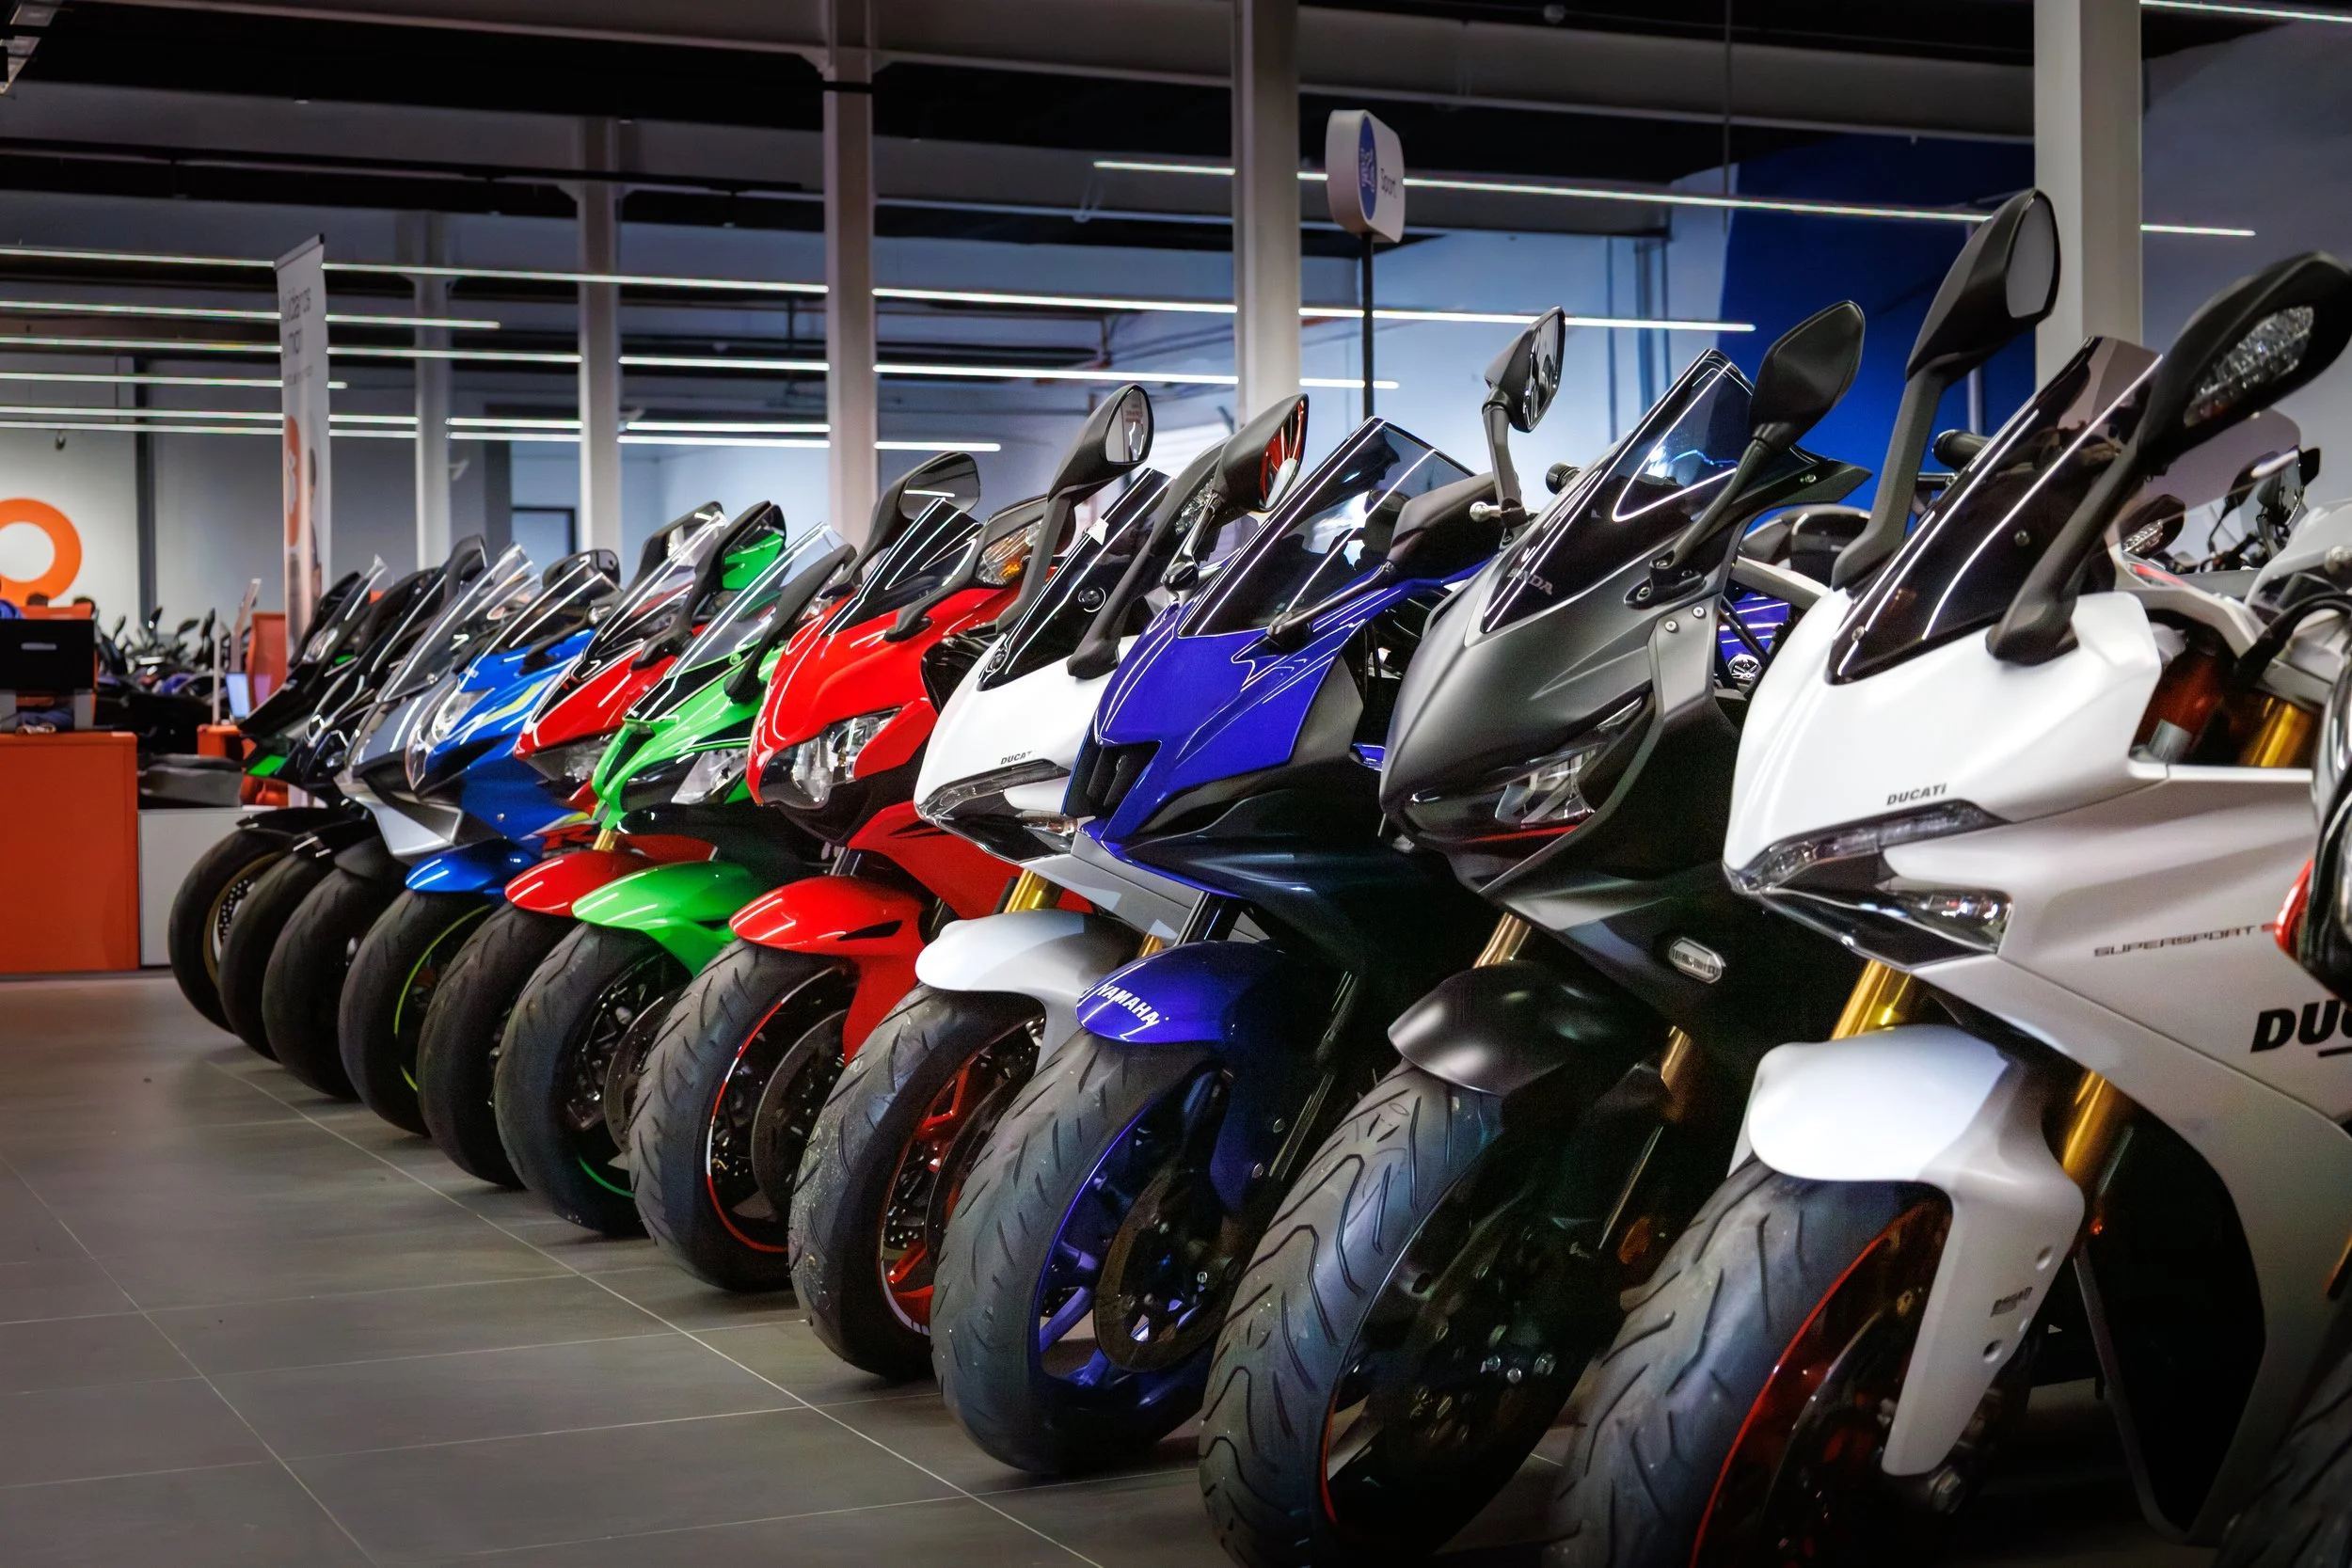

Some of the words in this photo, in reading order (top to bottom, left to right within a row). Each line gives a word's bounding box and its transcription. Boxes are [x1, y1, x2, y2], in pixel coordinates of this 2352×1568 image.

[1506, 567, 1553, 595] HNDA
[1000, 750, 1033, 765] DUCAT
[1887, 783, 1947, 805] DUCATI
[2094, 925, 2256, 958] SUPERSPORT
[1097, 984, 1160, 1027] YAMAHA
